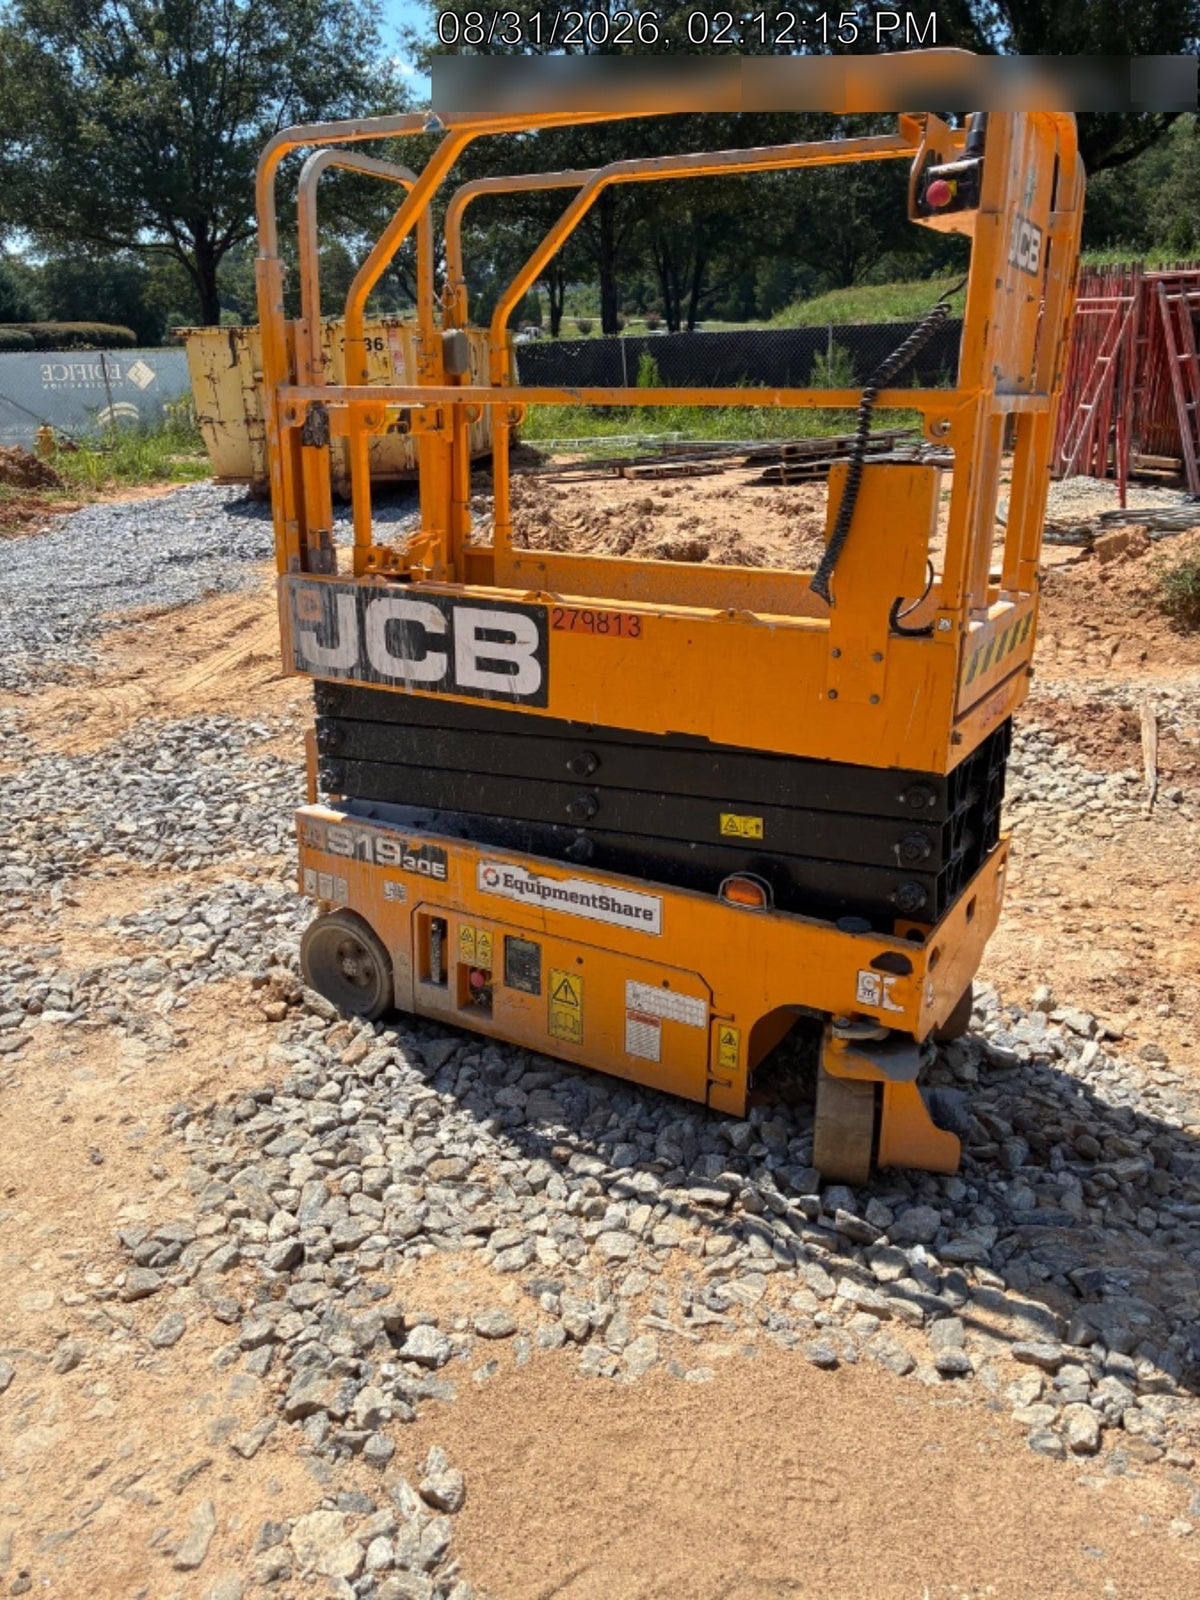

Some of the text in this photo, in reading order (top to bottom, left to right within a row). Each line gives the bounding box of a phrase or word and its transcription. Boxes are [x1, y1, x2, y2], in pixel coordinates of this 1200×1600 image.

[301, 594, 542, 695] JCB
[551, 607, 642, 638] 279813
[503, 872, 654, 921] EquipmentShare
